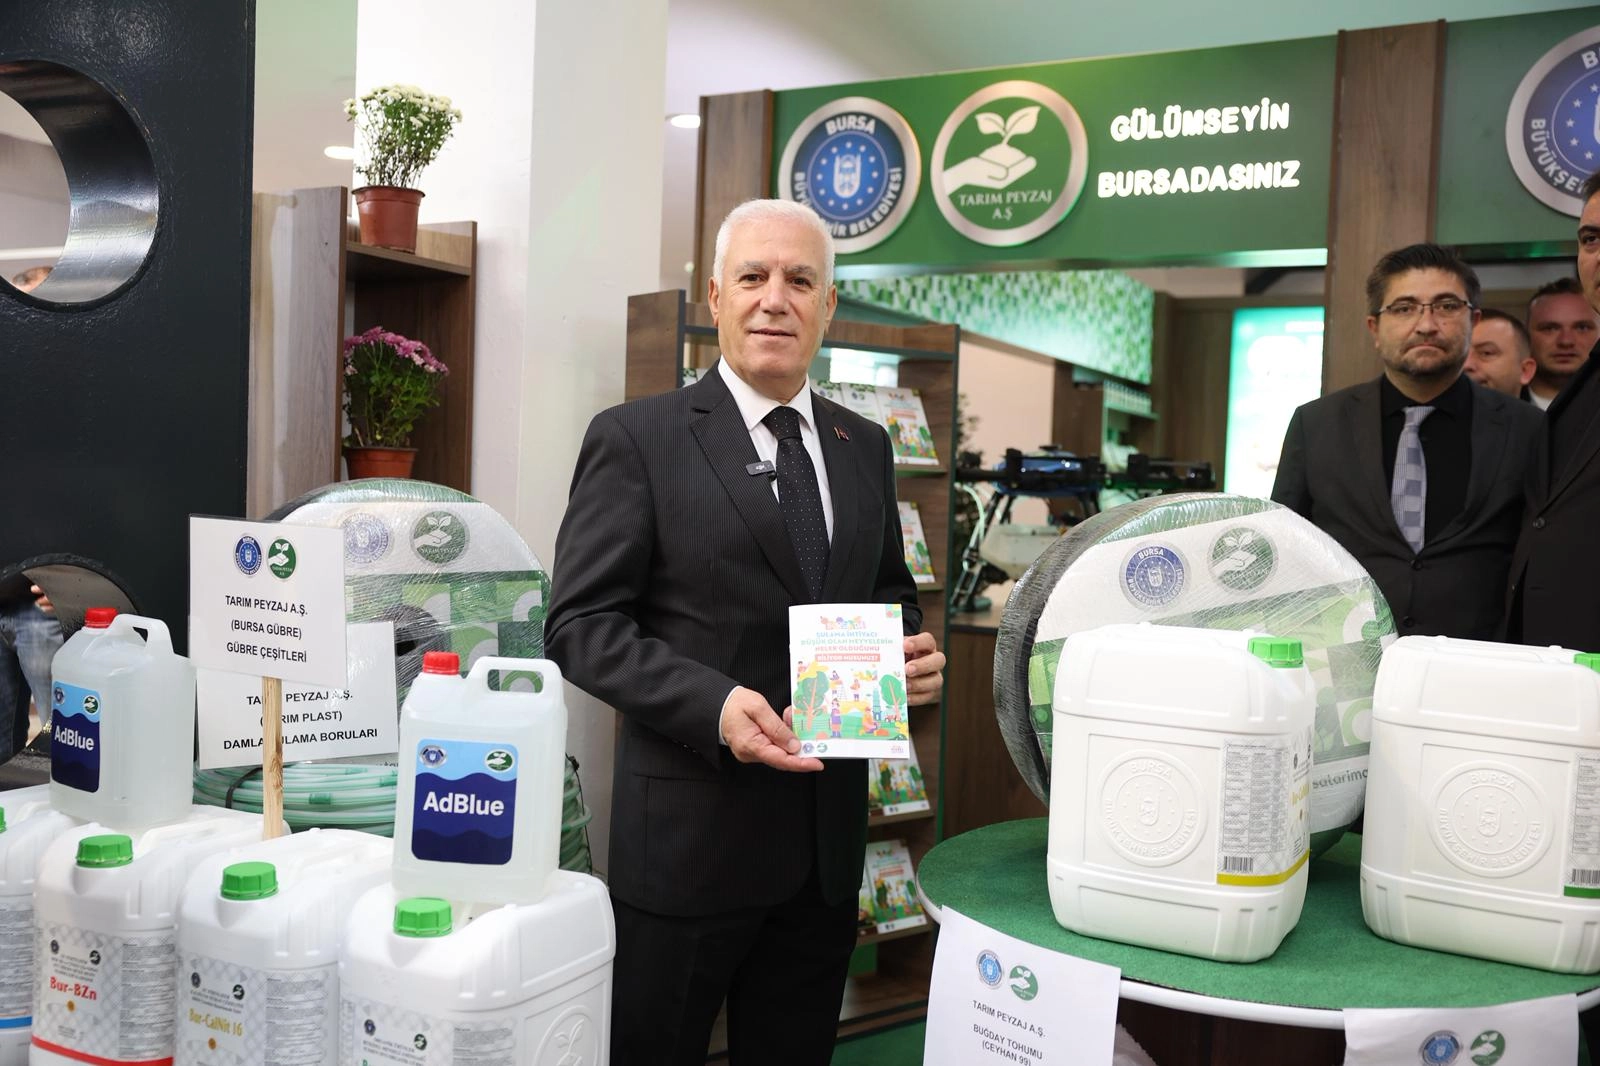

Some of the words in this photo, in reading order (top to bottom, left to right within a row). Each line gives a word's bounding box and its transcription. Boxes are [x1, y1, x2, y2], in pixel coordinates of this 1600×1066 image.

[825, 114, 876, 136] BURSA
[1110, 97, 1290, 142] GÜLÜMSEYİN
[1097, 160, 1301, 198] BURSADASINIZ
[960, 192, 1003, 206] TARIM
[1006, 189, 1052, 204] PEYZAJ
[1138, 548, 1165, 558] BURSA
[225, 595, 252, 608] TARIM
[254, 599, 288, 612] PEYZAJ
[290, 603, 308, 617] A.Ş.
[231, 619, 265, 633] (BURSA
[266, 623, 302, 640] GÜBRE)
[226, 641, 258, 656] GÜBRE
[260, 647, 307, 663] ÇEŞİTLERİ
[285, 691, 329, 703] PEYZAJ
[302, 710, 343, 723] PLAST)
[54, 725, 95, 751] AdBlue
[320, 728, 378, 742] BORULARI
[423, 791, 505, 816] AdBlue
[50, 976, 97, 1000] Bur-BZn
[973, 1000, 996, 1017] TARIM
[997, 1010, 1028, 1030] PEYZAJ
[1030, 1024, 1047, 1038] A.Ş.
[982, 1040, 1018, 1062] (CEYHAN
[1007, 1038, 1043, 1060] TOHUMU
